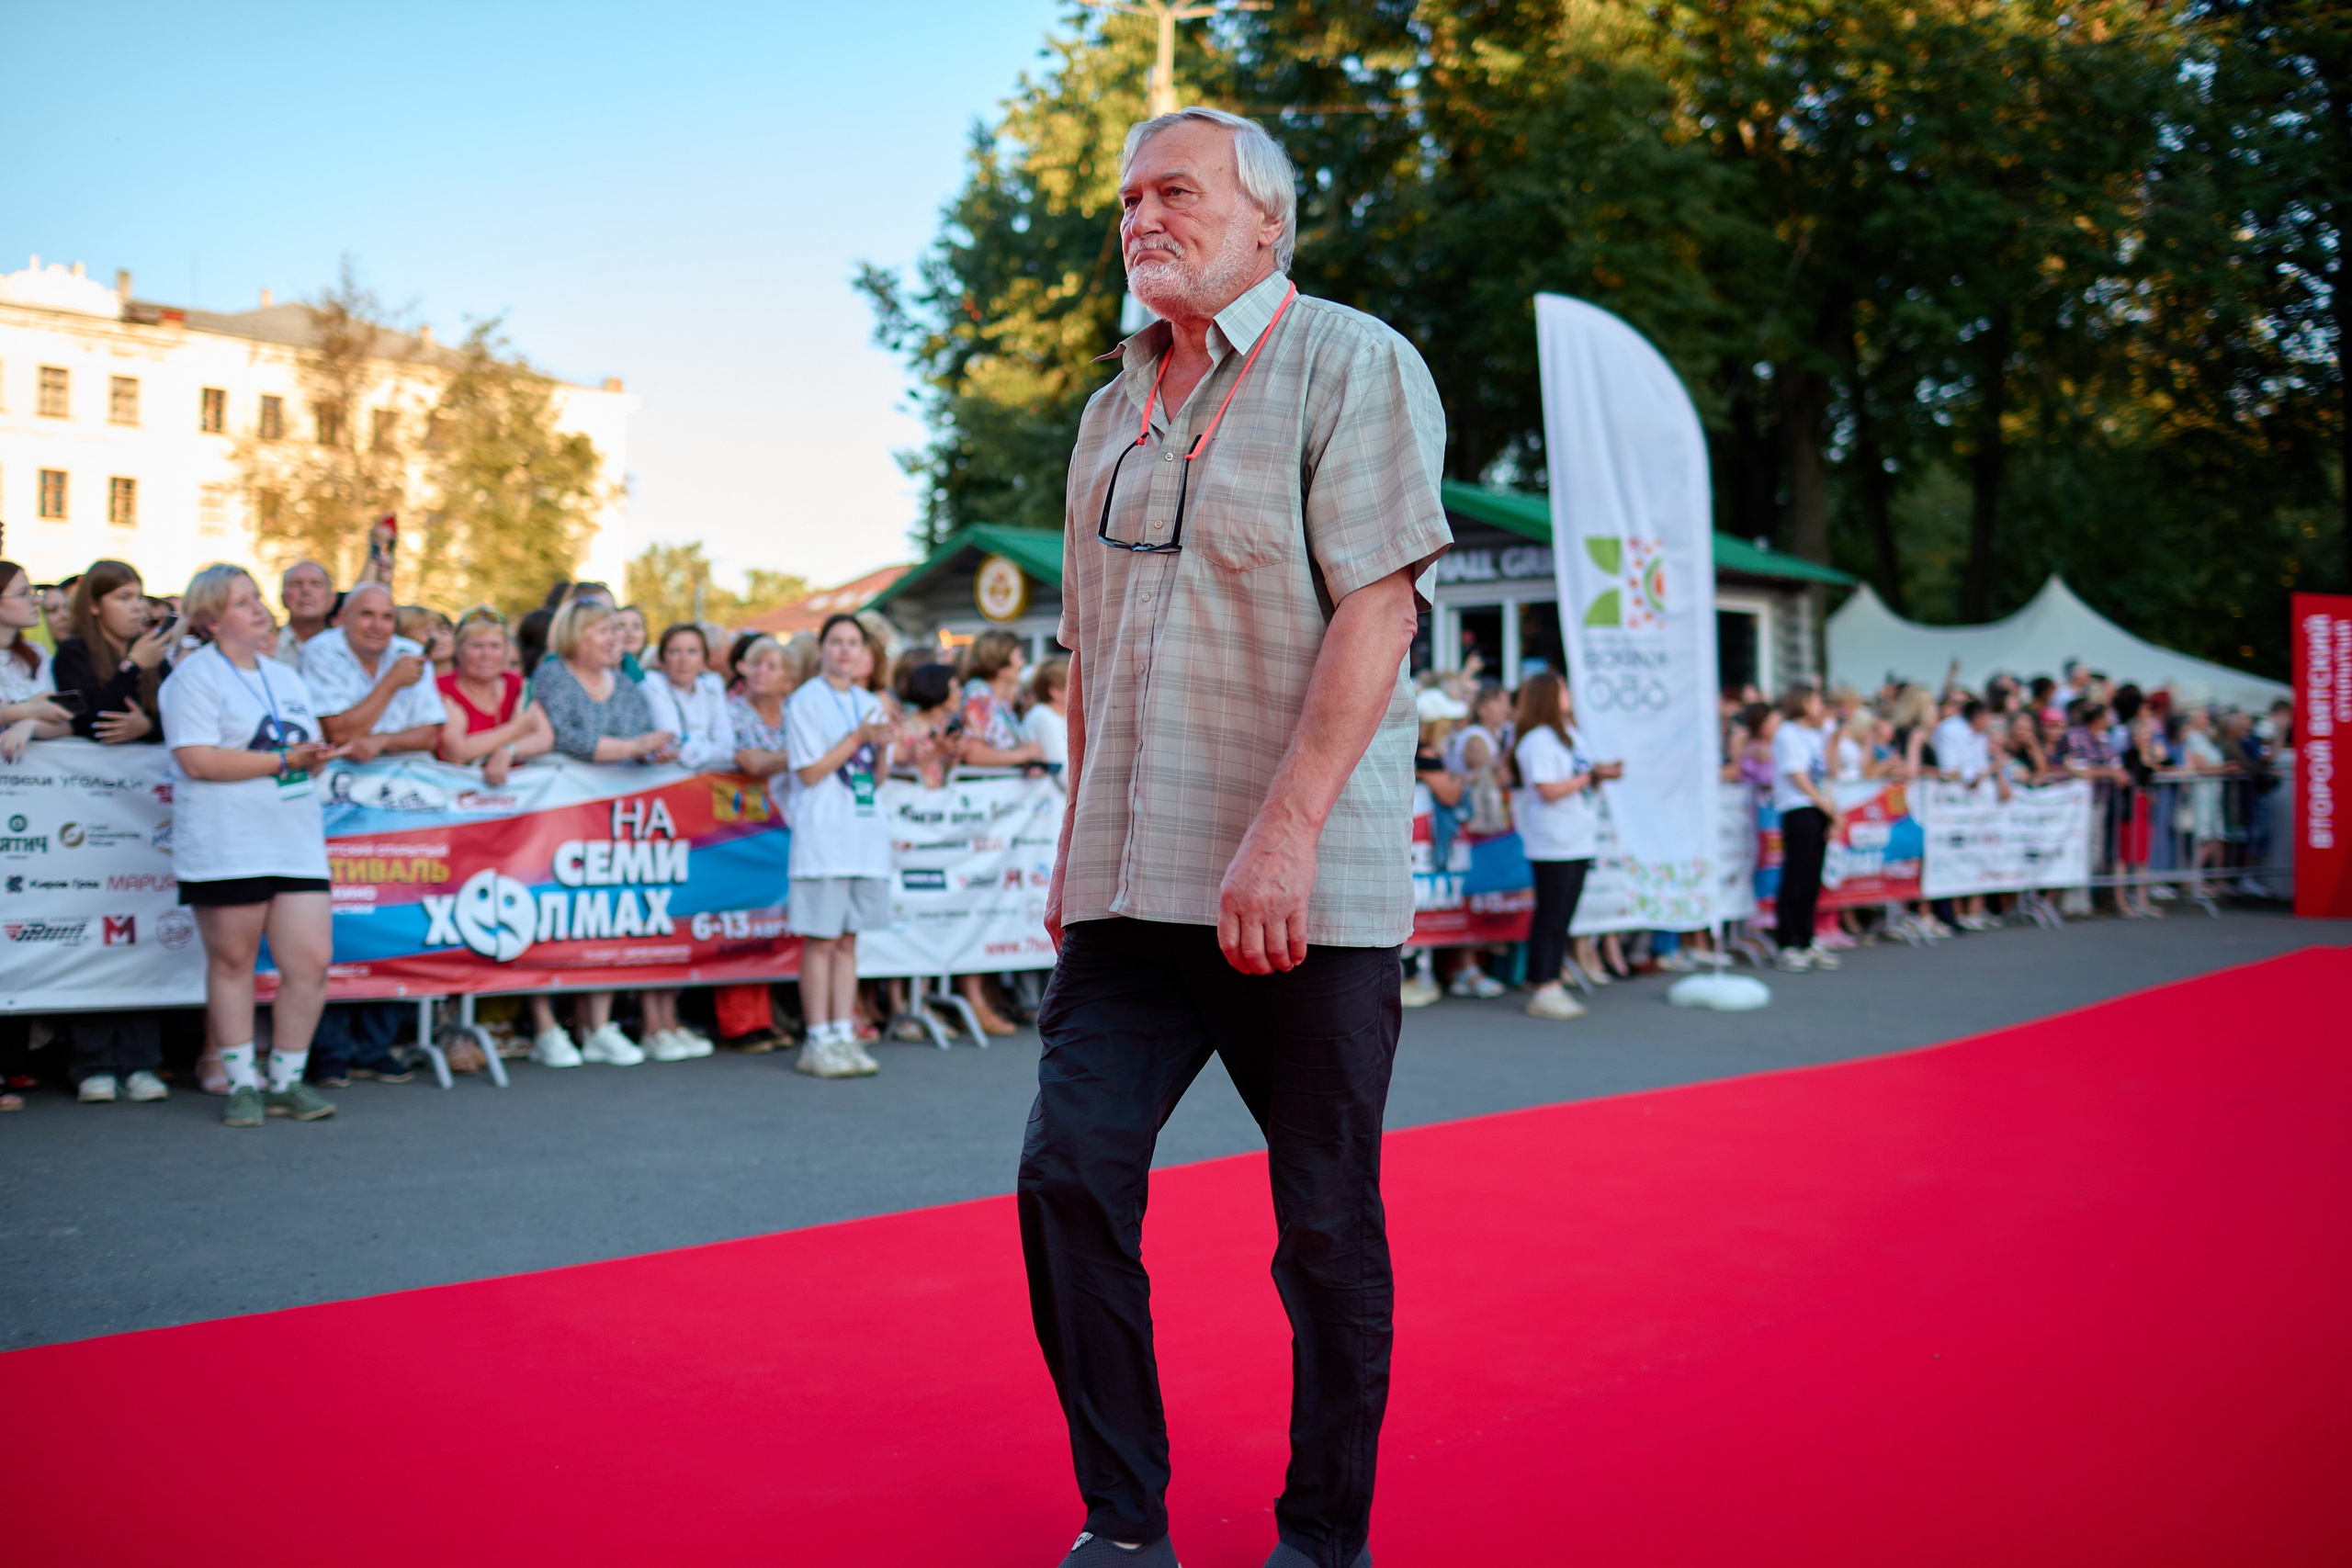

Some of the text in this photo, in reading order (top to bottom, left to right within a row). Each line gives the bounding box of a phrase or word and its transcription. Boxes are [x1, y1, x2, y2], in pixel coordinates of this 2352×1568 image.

[2303, 614, 2334, 849] ВТОРОЙ ВЯТСКИЙ
[612, 797, 677, 840] НА
[553, 839, 690, 886] СЕМИ
[692, 910, 750, 941] 6-13
